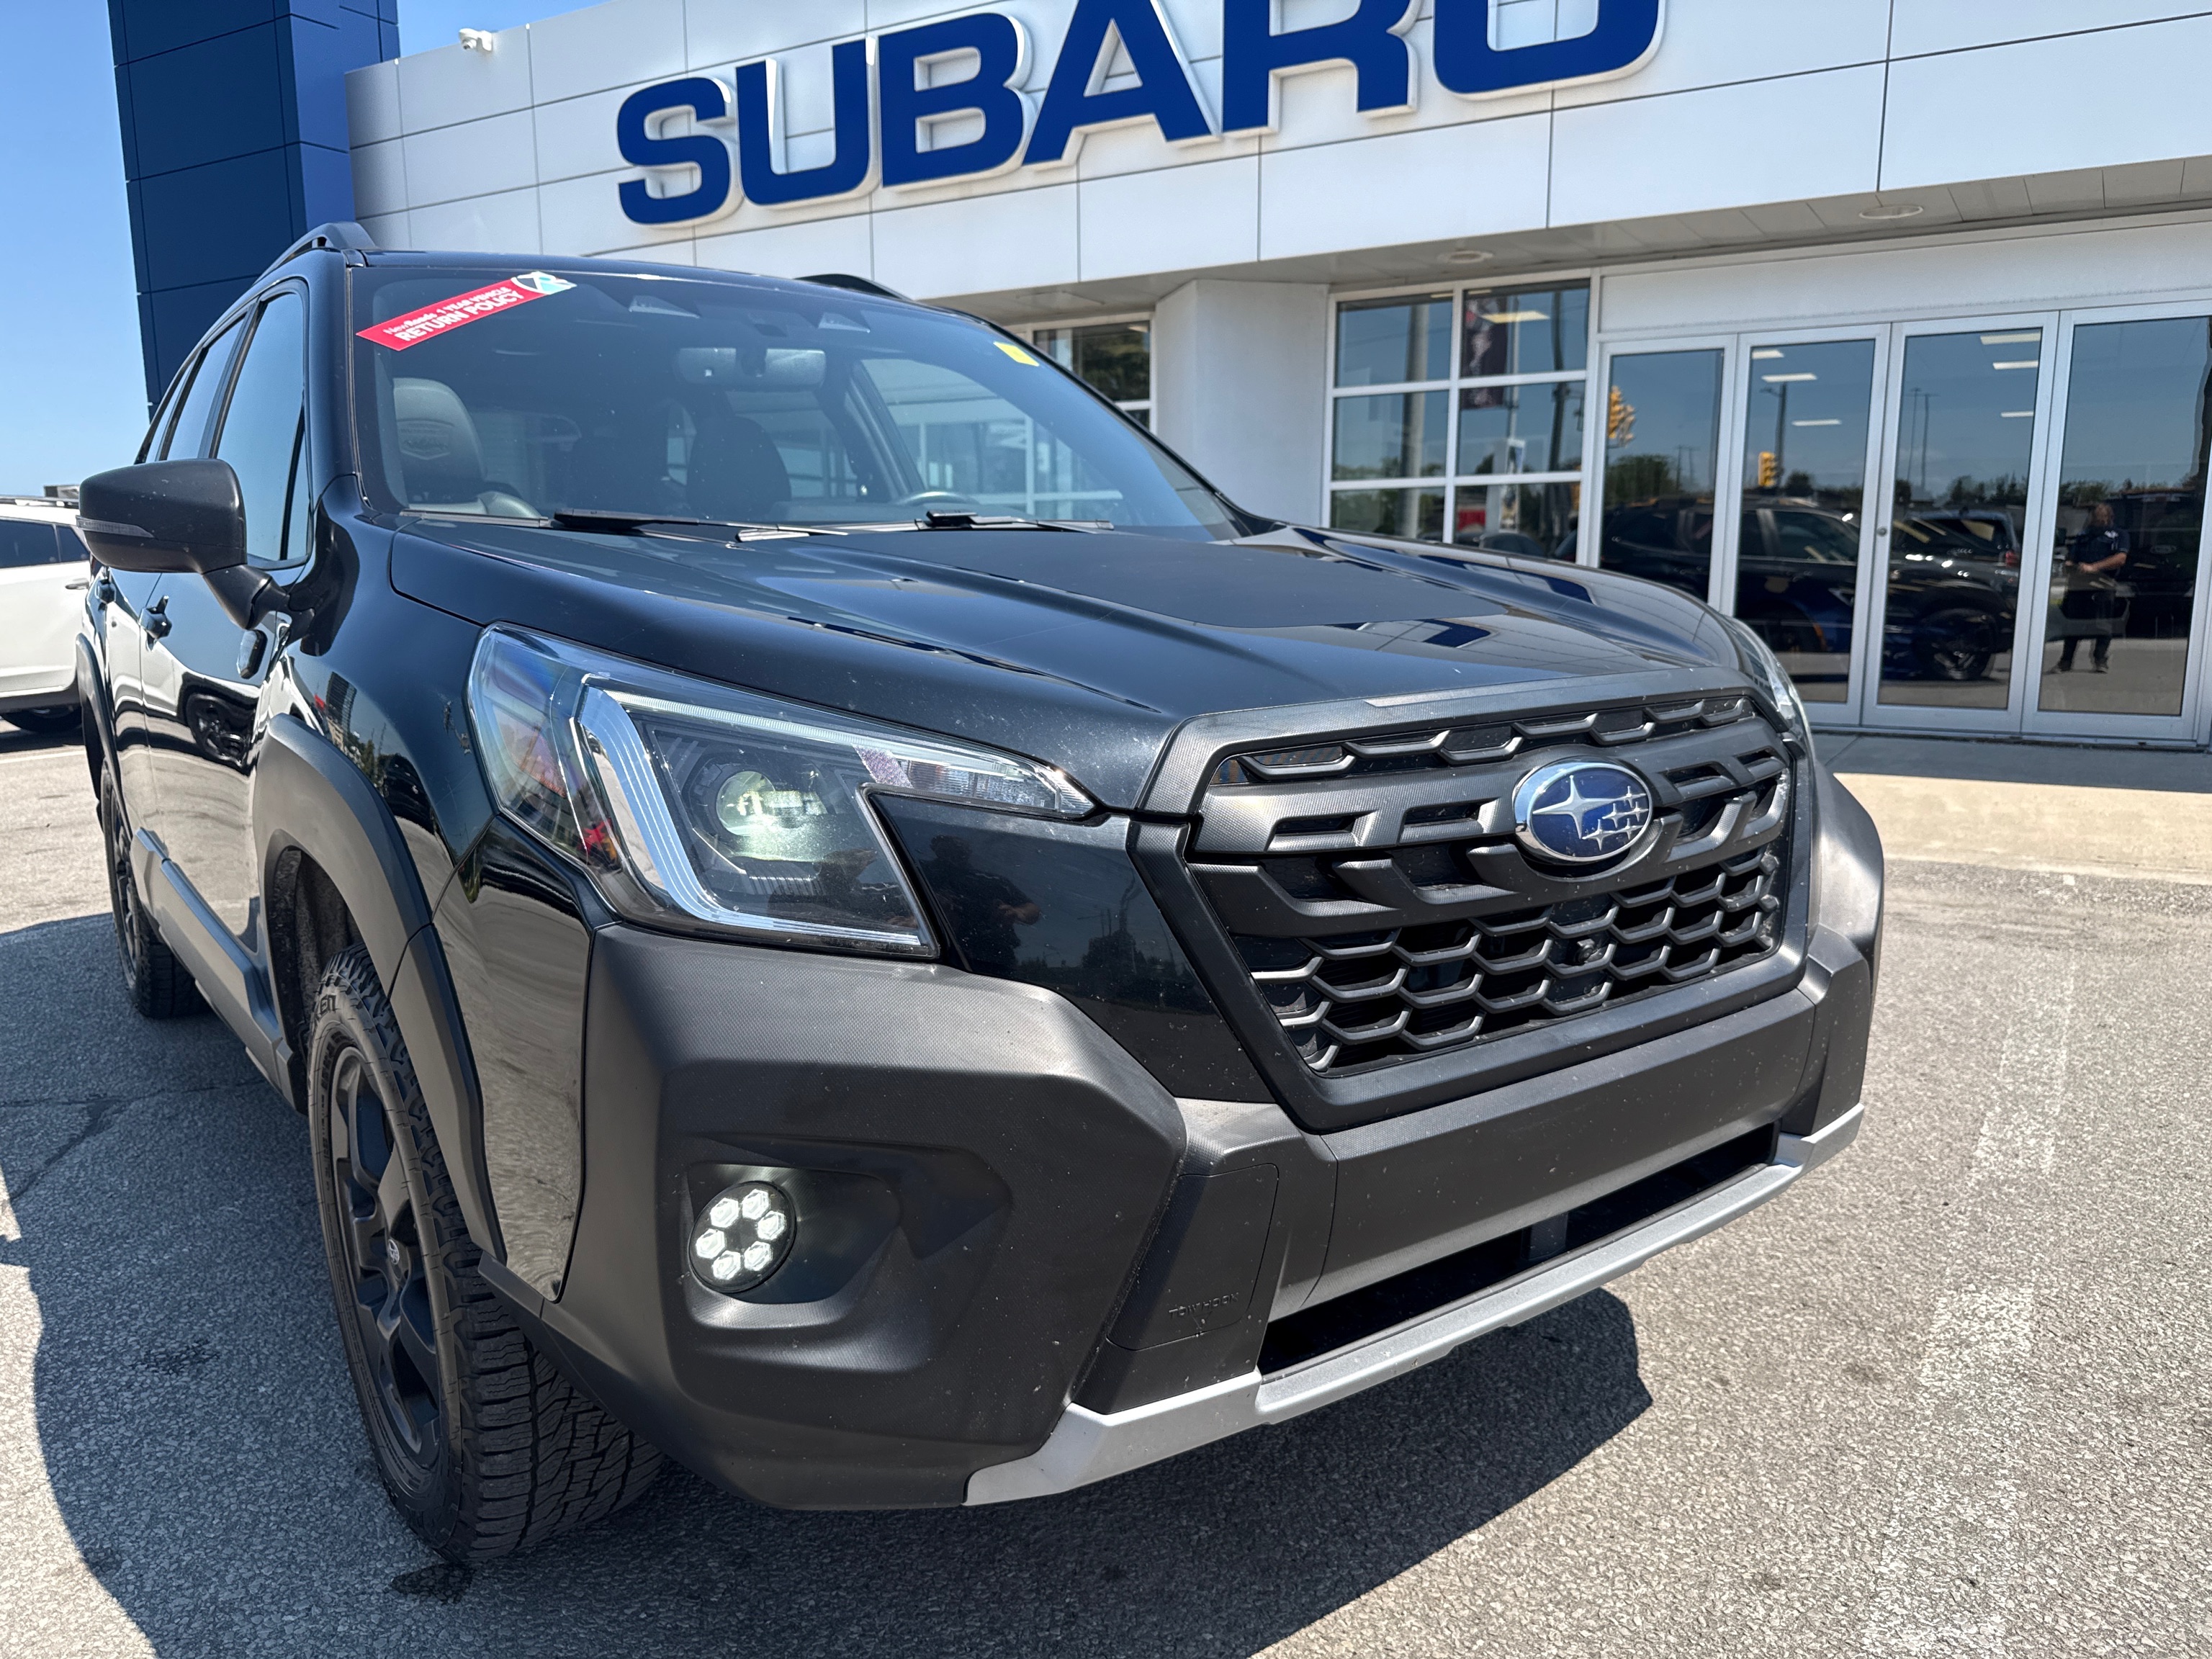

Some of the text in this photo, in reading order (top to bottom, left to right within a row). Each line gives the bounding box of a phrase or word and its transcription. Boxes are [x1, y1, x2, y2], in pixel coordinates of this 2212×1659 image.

[617, 0, 1660, 225] SUBARU
[394, 290, 525, 342] RETURN POLICY
[443, 299, 474, 312] YEAR
[469, 287, 512, 302] VEHICLE
